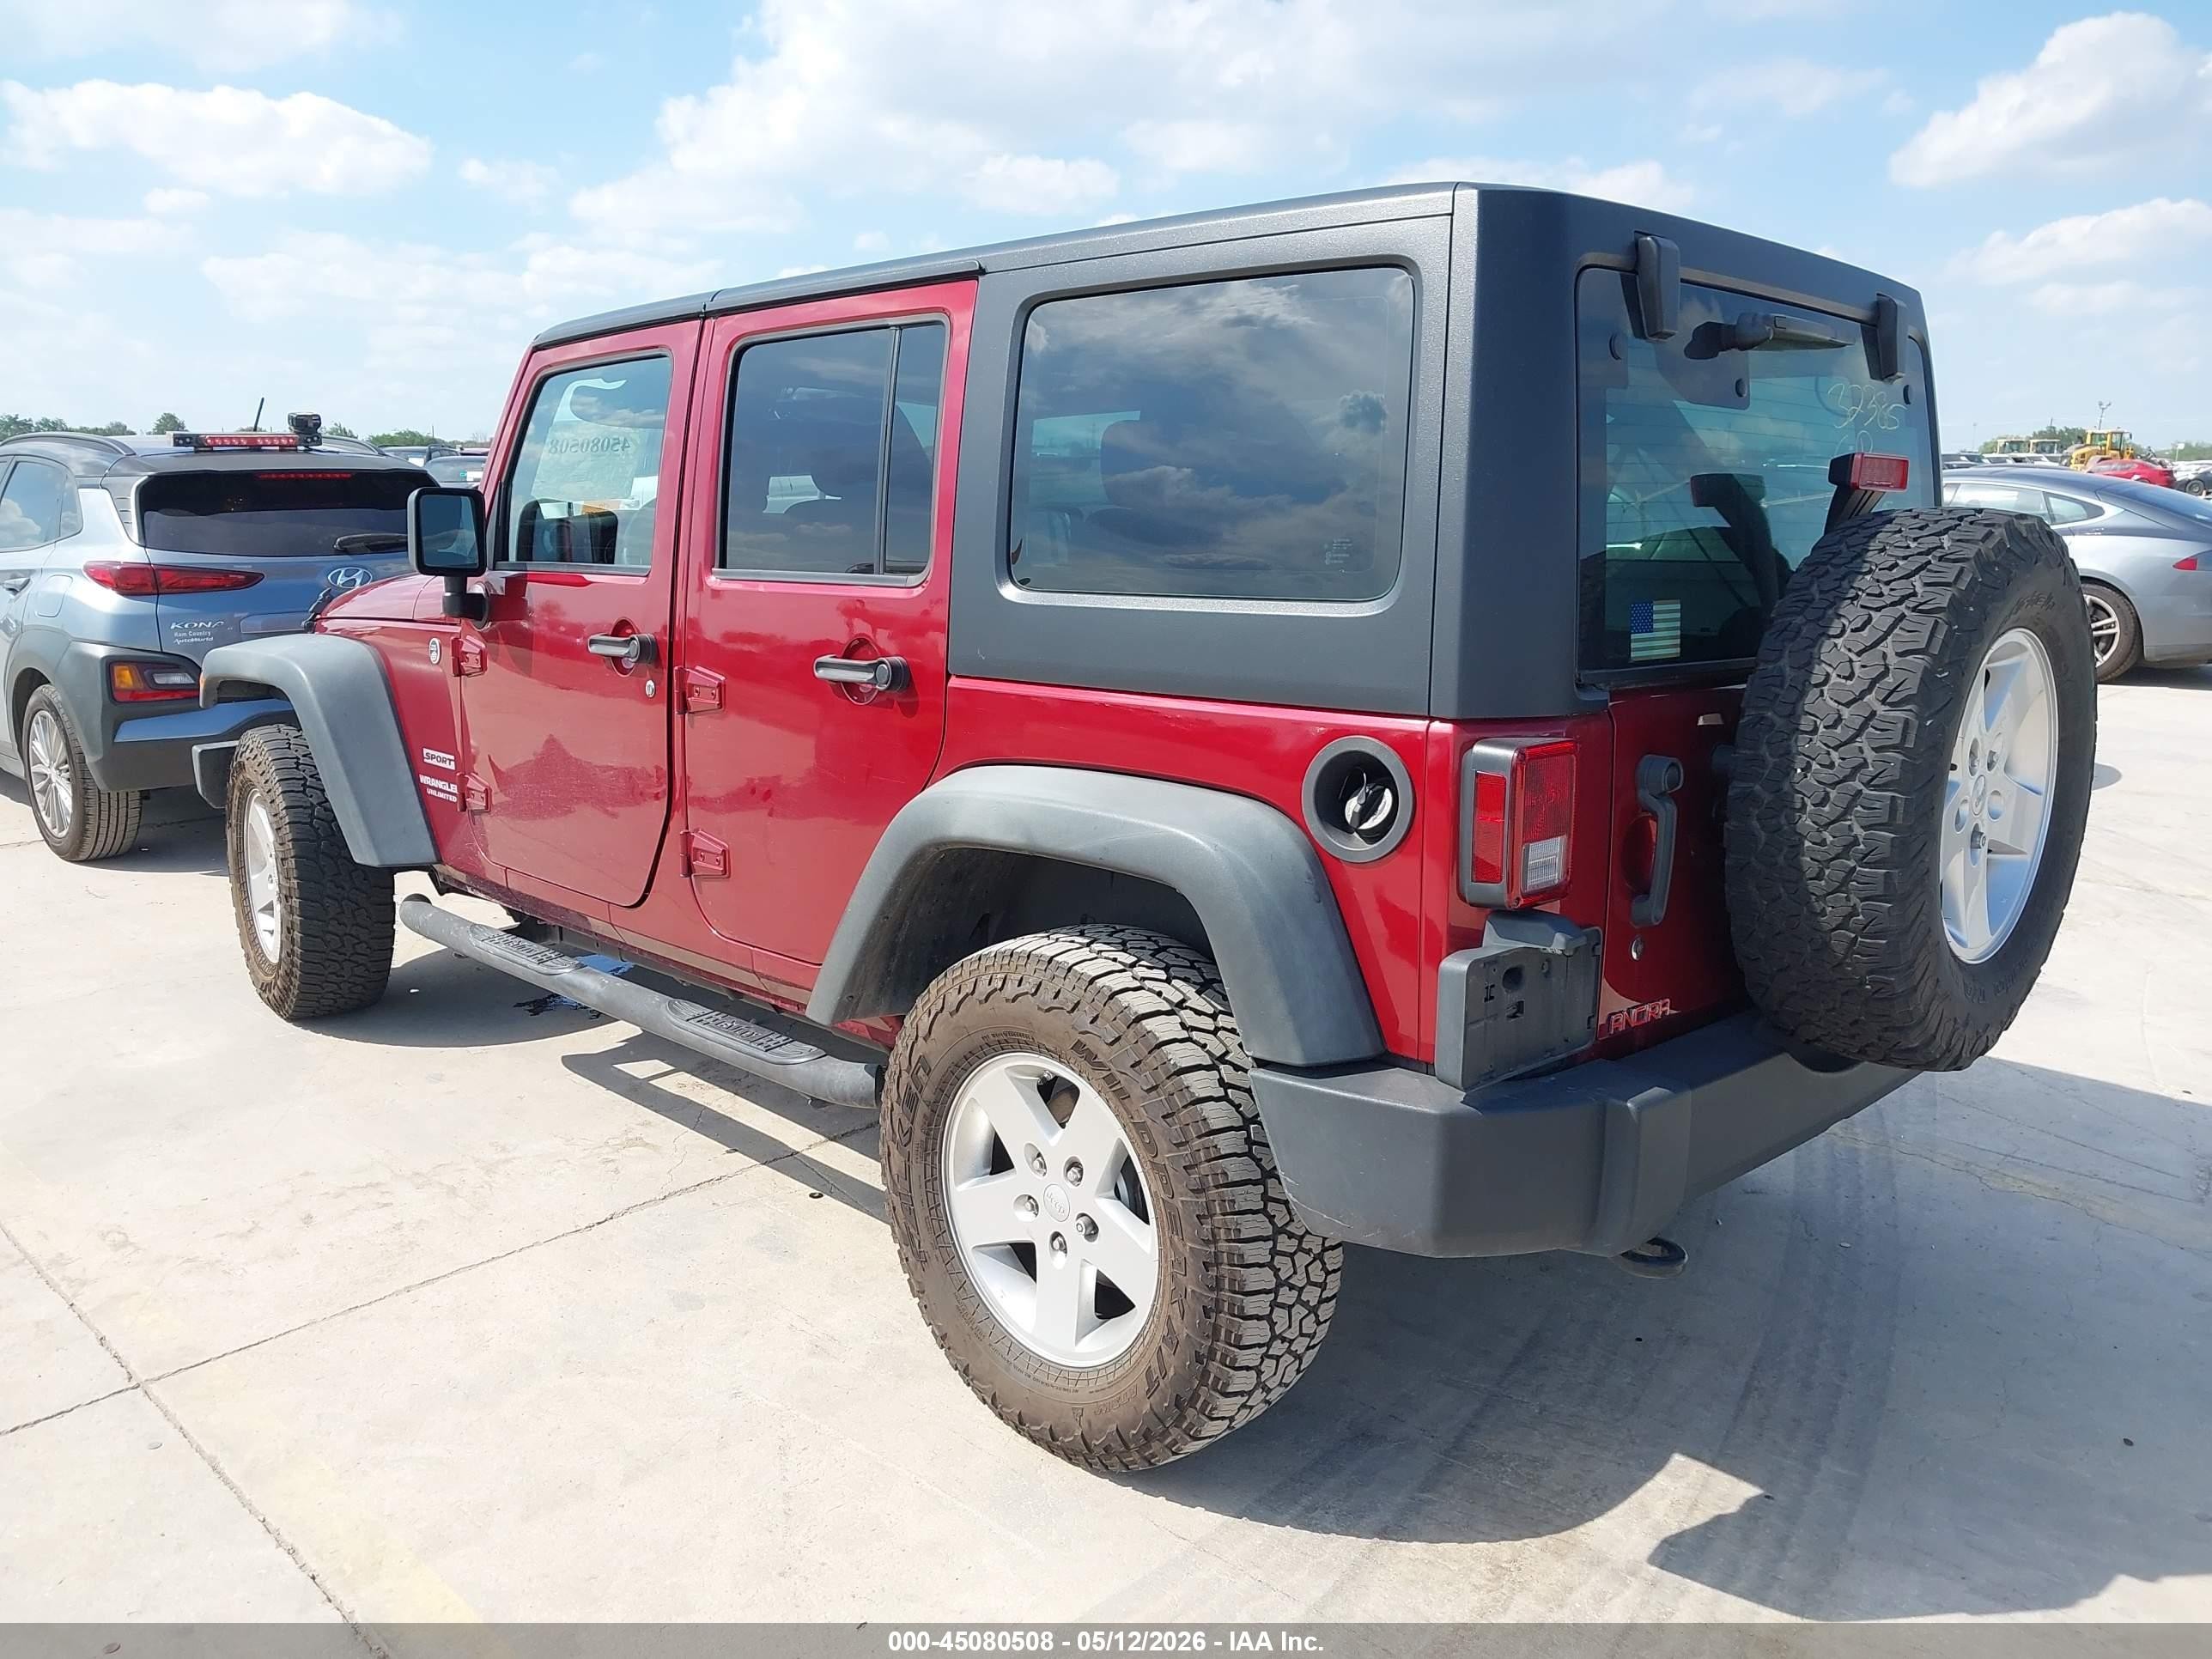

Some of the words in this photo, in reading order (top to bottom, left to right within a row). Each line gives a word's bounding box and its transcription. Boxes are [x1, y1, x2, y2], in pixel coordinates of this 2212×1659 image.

[424, 752, 455, 766] SPORT
[419, 774, 459, 794] WRANGLE
[426, 787, 459, 803] UNLIMITED
[898, 1053, 932, 1267] FALKEN
[1046, 1192, 1065, 1214] Jeep
